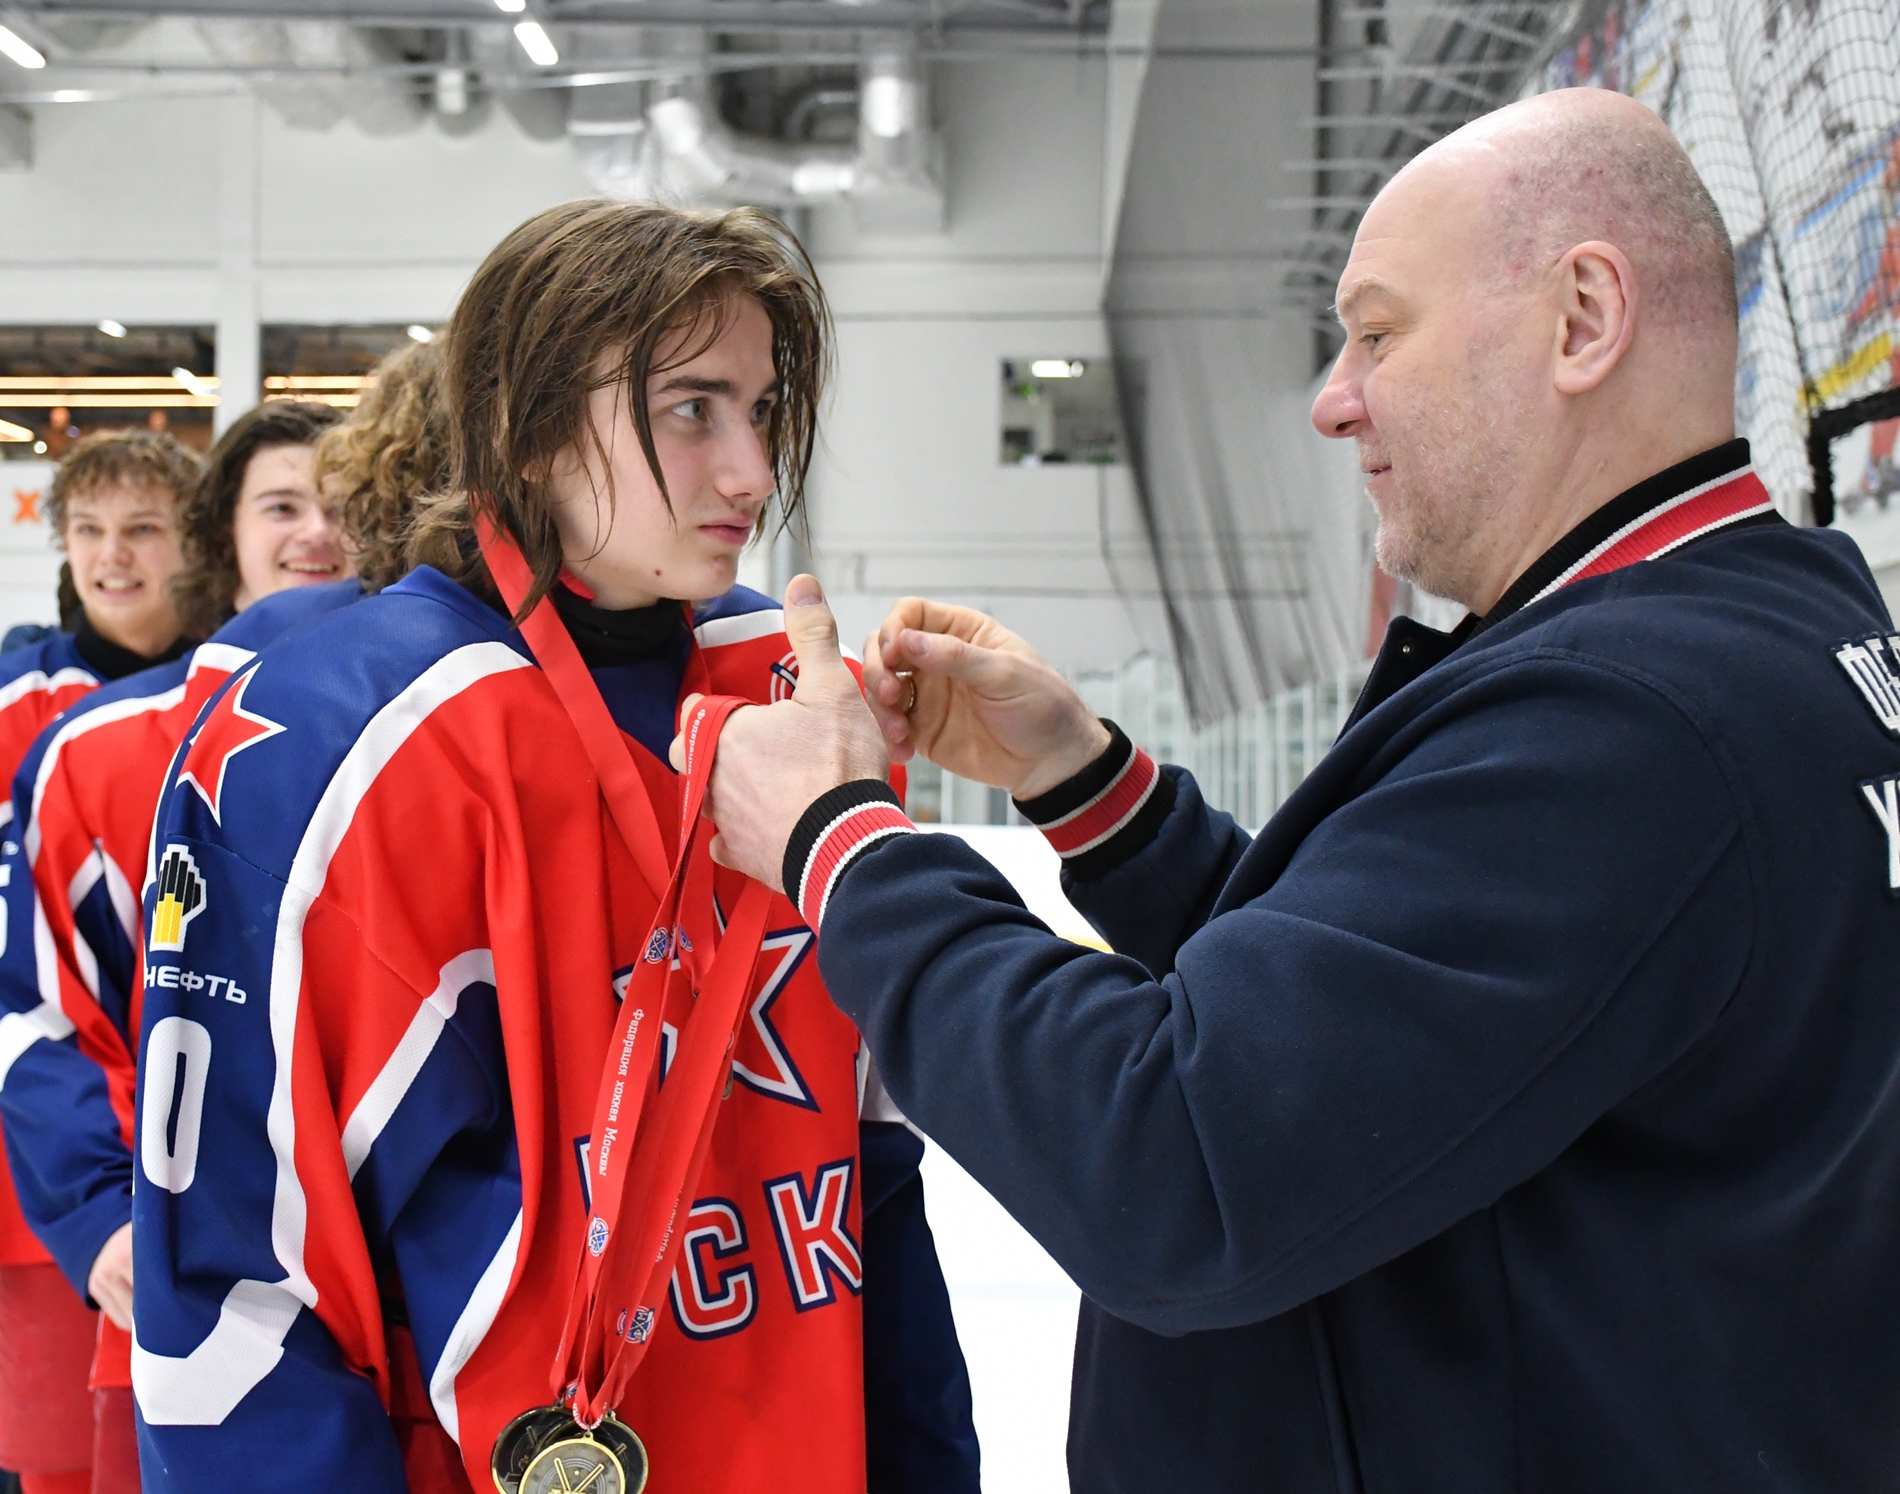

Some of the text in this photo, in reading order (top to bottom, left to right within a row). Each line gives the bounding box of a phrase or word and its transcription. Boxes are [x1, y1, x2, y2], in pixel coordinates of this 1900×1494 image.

[141, 1016, 212, 1194] 0
[599, 1008, 645, 1177] Федерация хоккея Москвы
[573, 1134, 862, 1341] СК
